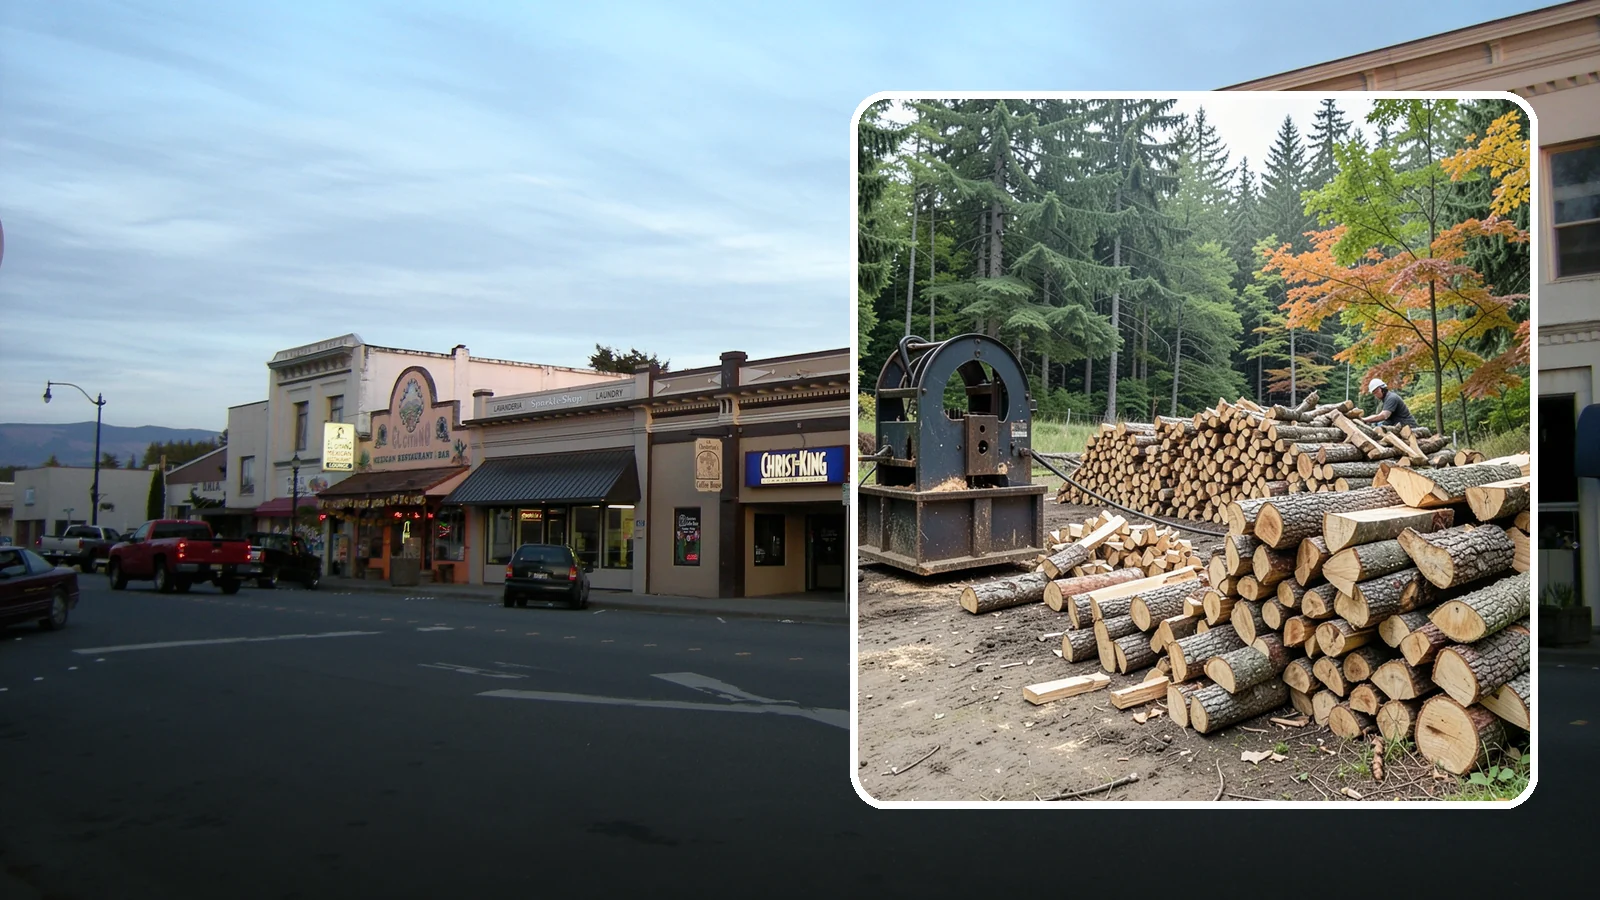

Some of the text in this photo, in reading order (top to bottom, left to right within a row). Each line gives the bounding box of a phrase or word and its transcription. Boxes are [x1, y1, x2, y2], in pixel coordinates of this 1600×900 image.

[531, 394, 582, 408] Sparkle Shop
[595, 389, 623, 400] LAUNDRY
[493, 402, 522, 412] LAVANDERIA
[374, 454, 396, 464] MEXICAN
[397, 451, 433, 462] RESTAURANT
[438, 450, 450, 459] BAR
[761, 450, 827, 478] CHRIST KING
